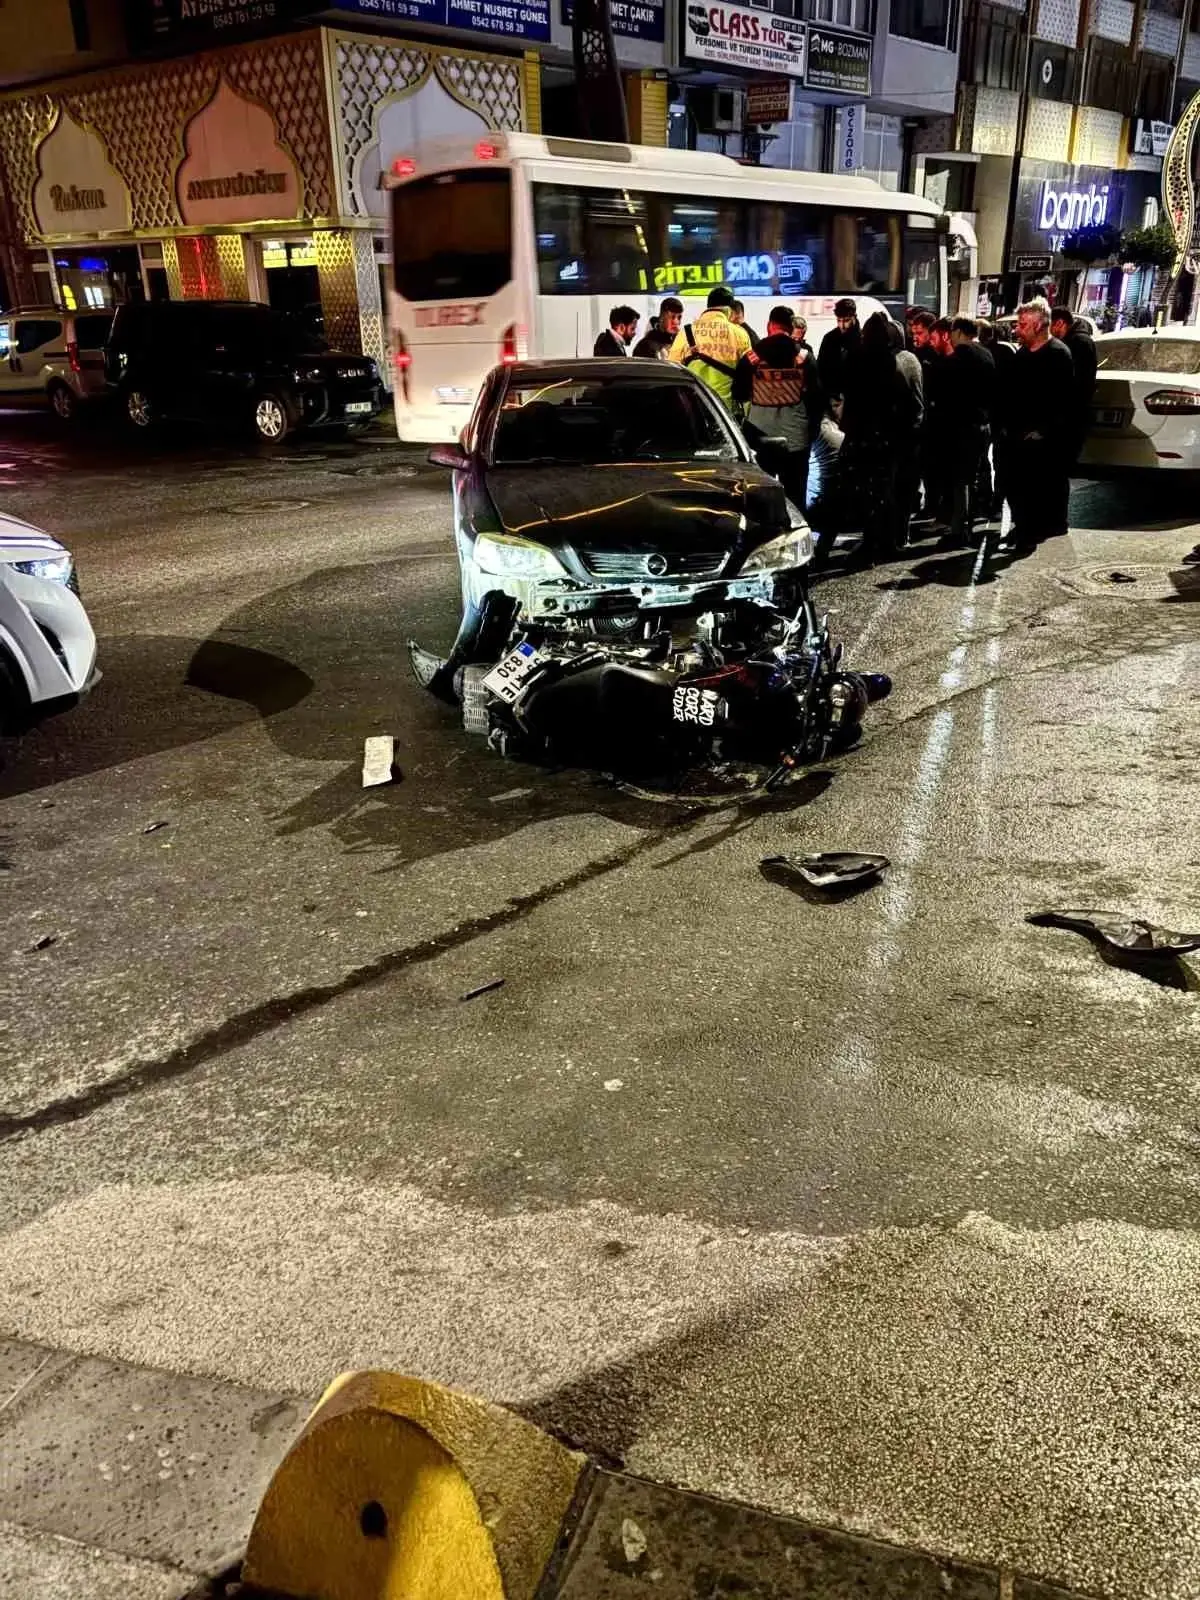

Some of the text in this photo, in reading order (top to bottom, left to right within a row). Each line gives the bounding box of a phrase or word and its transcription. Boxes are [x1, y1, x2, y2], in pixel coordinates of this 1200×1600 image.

[450, 0, 548, 25] AHMET NUSRET GÜNEL
[630, 6, 655, 22] ÇAKIR
[709, 8, 759, 40] CLASS
[695, 36, 728, 49] PERSONEL
[729, 42, 737, 52] VE
[821, 38, 869, 60] MG BOZMAN
[845, 107, 856, 168] eczane
[1040, 180, 1109, 229] bambi
[1020, 259, 1047, 267] bambi
[497, 655, 523, 678] 830
[673, 686, 686, 721] RIDER
[685, 687, 699, 724] CORE
